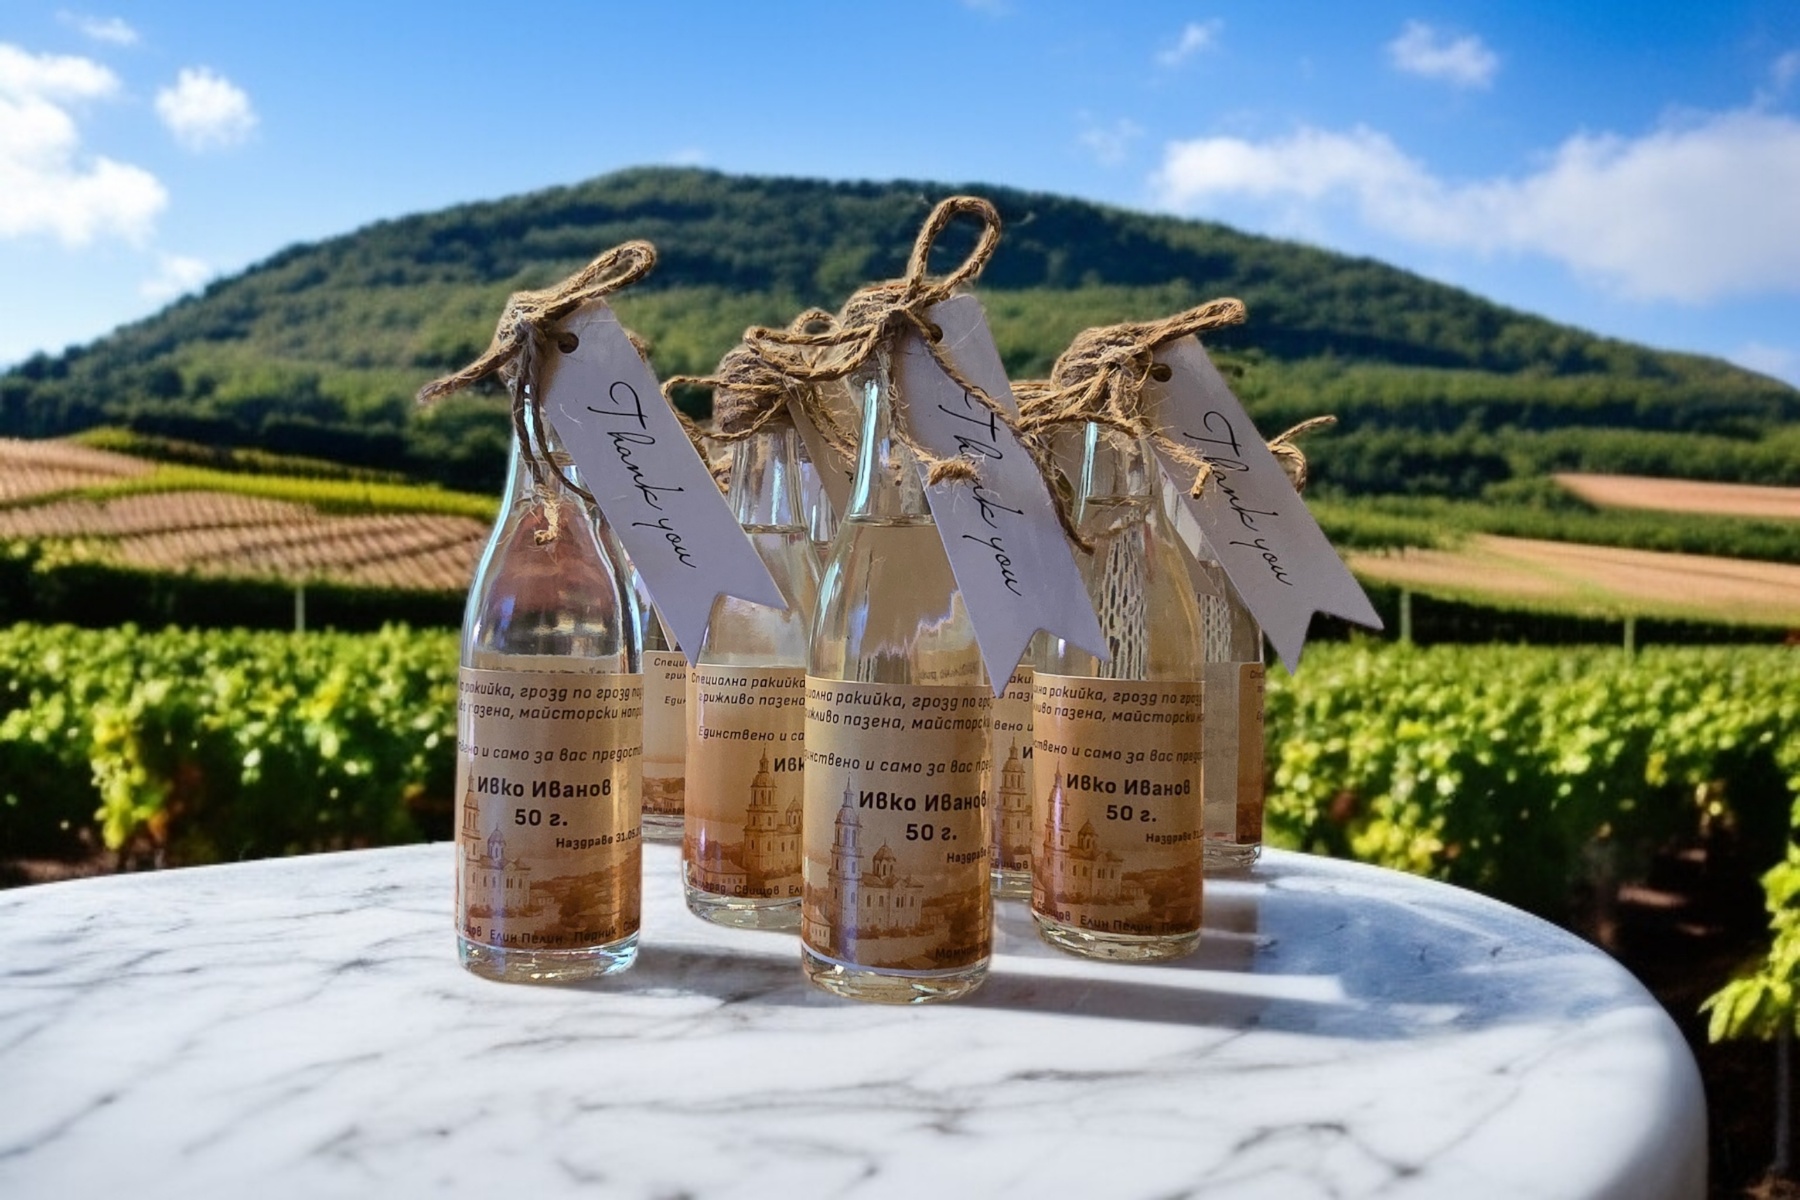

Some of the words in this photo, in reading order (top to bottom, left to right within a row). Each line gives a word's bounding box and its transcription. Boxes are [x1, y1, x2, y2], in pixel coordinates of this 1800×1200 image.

[587, 381, 684, 511] Thank
[938, 386, 1024, 529] Thnk
[1182, 411, 1279, 532] Thank
[632, 518, 697, 569] you
[962, 536, 1022, 597] you
[1229, 538, 1293, 587] you
[654, 657, 687, 668] Специ
[691, 672, 747, 687] Специална
[520, 687, 567, 701] грозд
[573, 689, 592, 698] по
[596, 688, 630, 701] грозд
[699, 693, 755, 705] грижливо
[836, 690, 905, 710] ракийка,
[911, 697, 958, 711] грозд
[962, 697, 976, 708] по
[1049, 686, 1107, 703] ракийка,
[1112, 691, 1157, 706] грозд
[1161, 694, 1177, 703] по
[519, 704, 618, 722] майсторски
[1054, 706, 1106, 722] пазена,
[1111, 710, 1196, 726] майсторски
[843, 715, 905, 731] пазена,
[699, 726, 775, 742] Единствено
[482, 747, 489, 757] и
[493, 748, 529, 761] само
[533, 751, 553, 764] за
[559, 748, 587, 761] вас
[1071, 747, 1080, 756] и
[1084, 748, 1121, 761] само
[1125, 750, 1144, 764] за
[1149, 749, 1173, 761] вас
[865, 760, 874, 771] и
[880, 760, 921, 773] само
[926, 763, 945, 776] за
[950, 760, 973, 773] вас
[477, 775, 524, 797] Ивко
[532, 778, 611, 798] Иванов
[1066, 773, 1117, 795] Ивко
[1123, 779, 1190, 796] Иванов
[859, 790, 916, 810] Ивко
[924, 790, 986, 812] Иванов
[515, 809, 541, 826] 50
[549, 813, 568, 826] г.
[1106, 805, 1133, 821] 50
[1140, 809, 1157, 822] г.
[906, 823, 933, 841] 50
[941, 827, 957, 841] г.
[556, 834, 613, 850] Наздраве
[734, 885, 780, 897] Свищов
[1080, 914, 1109, 930] Елин
[1113, 919, 1152, 932] Пелин
[490, 929, 517, 943] Елин
[521, 932, 563, 944] Пелин
[574, 926, 617, 943] Перник
